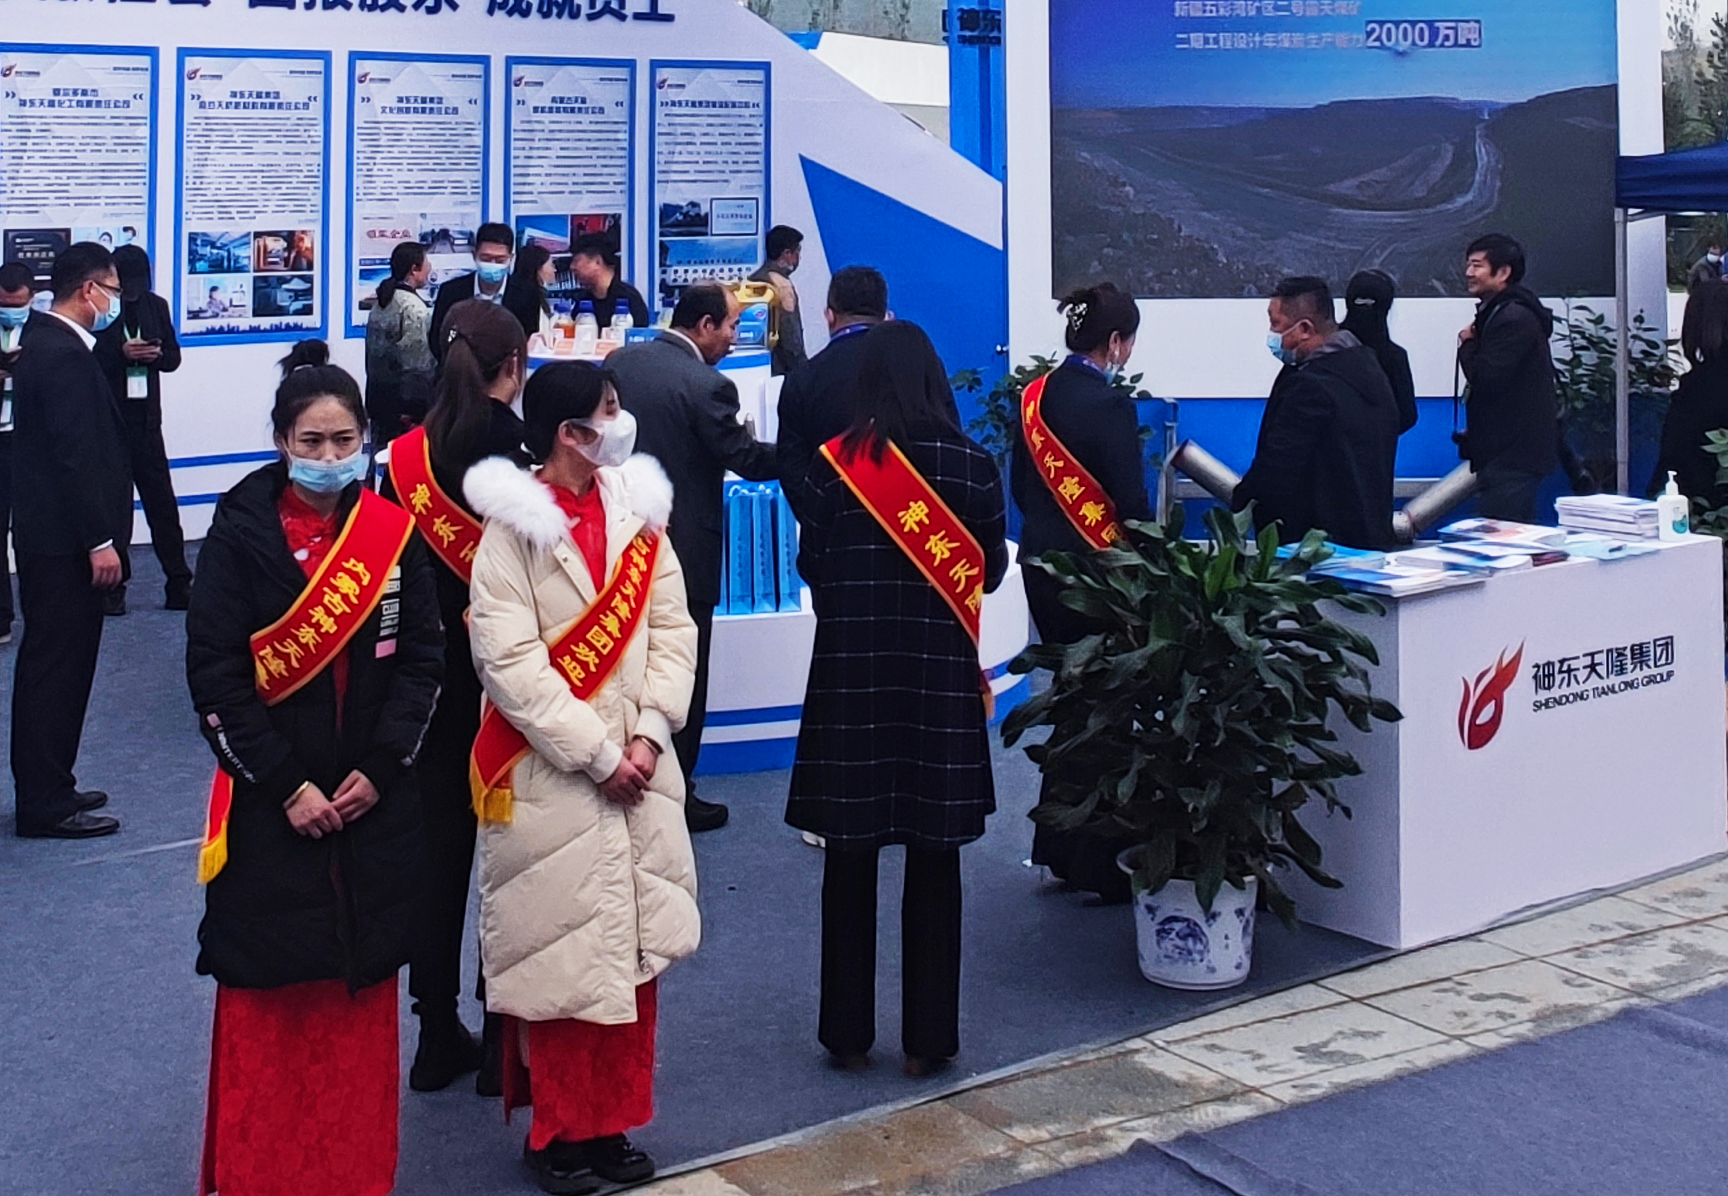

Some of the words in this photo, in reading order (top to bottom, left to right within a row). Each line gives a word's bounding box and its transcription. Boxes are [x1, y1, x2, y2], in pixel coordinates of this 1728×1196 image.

[1366, 22, 1430, 47] 2000
[1434, 21, 1480, 47] 万吨
[1532, 635, 1674, 696] 神东天隆集团
[1532, 689, 1589, 712] SHENDONG
[1591, 677, 1641, 699] TIANLONG
[1641, 670, 1675, 687] GROUP
